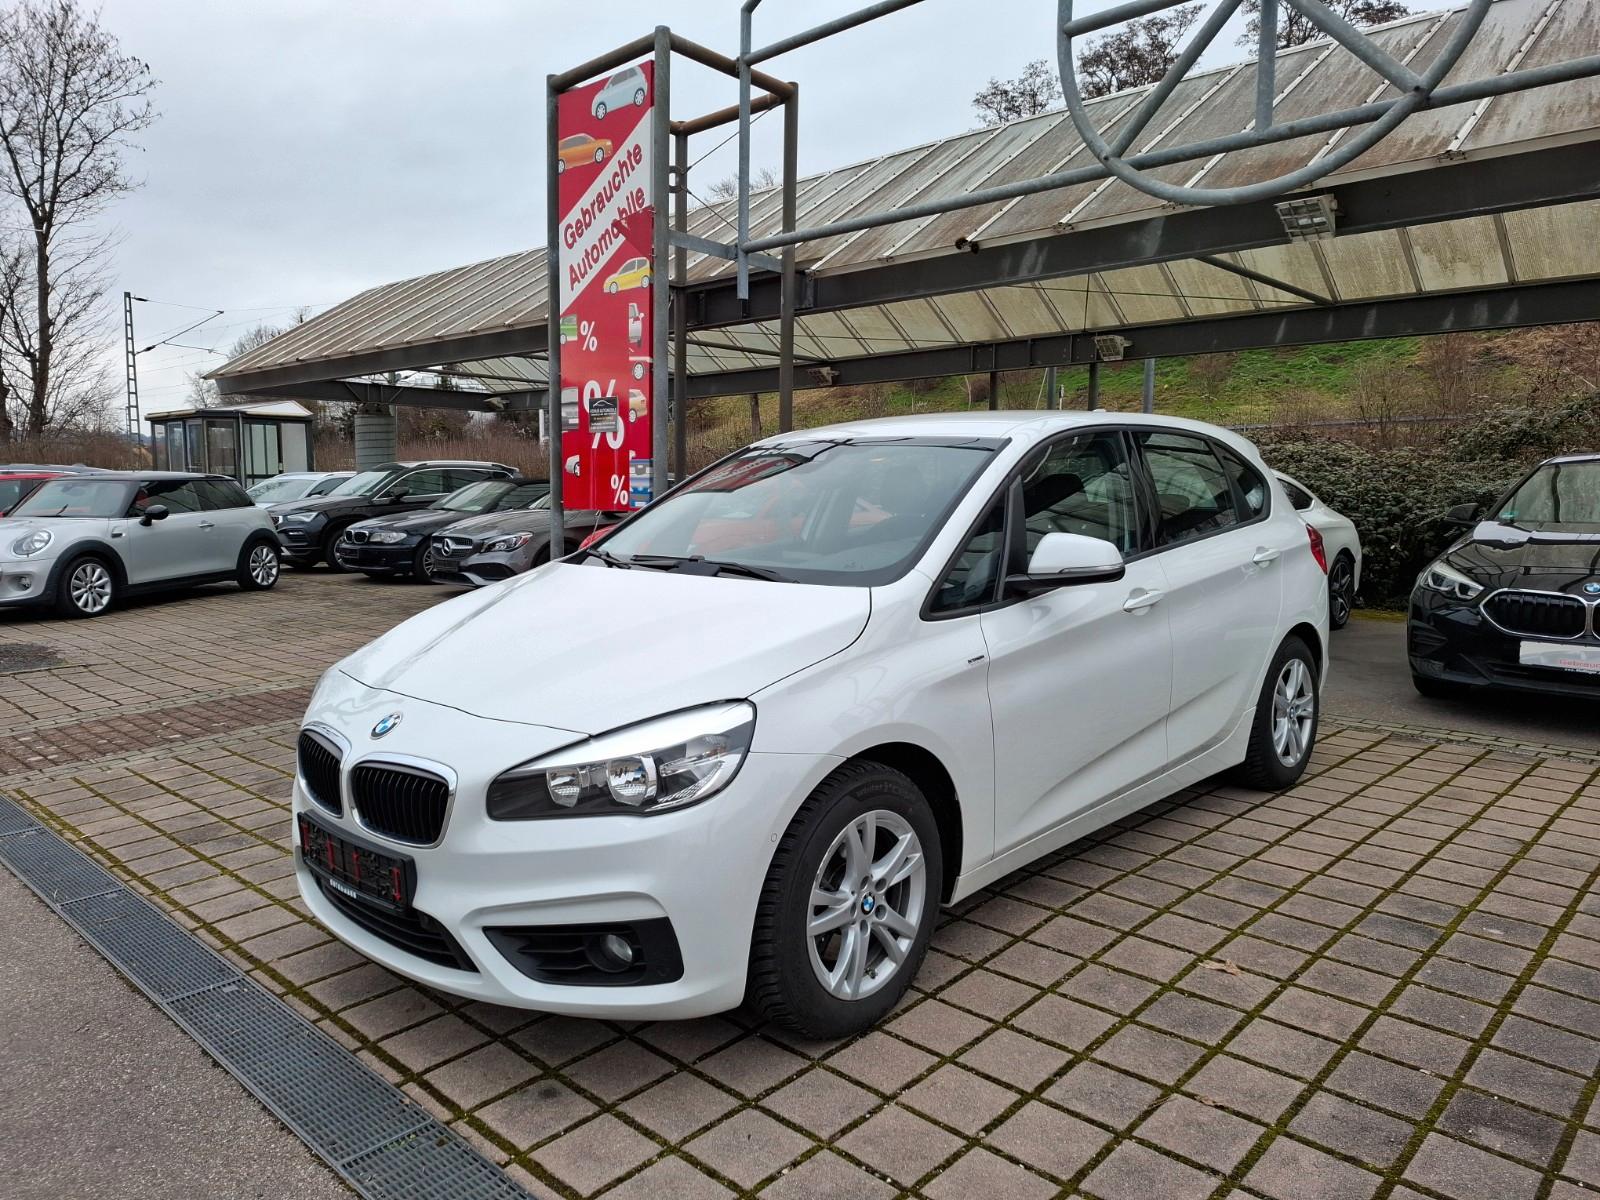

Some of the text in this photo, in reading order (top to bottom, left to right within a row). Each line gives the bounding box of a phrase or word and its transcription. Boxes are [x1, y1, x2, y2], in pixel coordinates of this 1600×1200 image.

[564, 143, 643, 249] Gebrauchte
[580, 320, 598, 352] %
[583, 379, 625, 449] %
[610, 474, 629, 505] %
